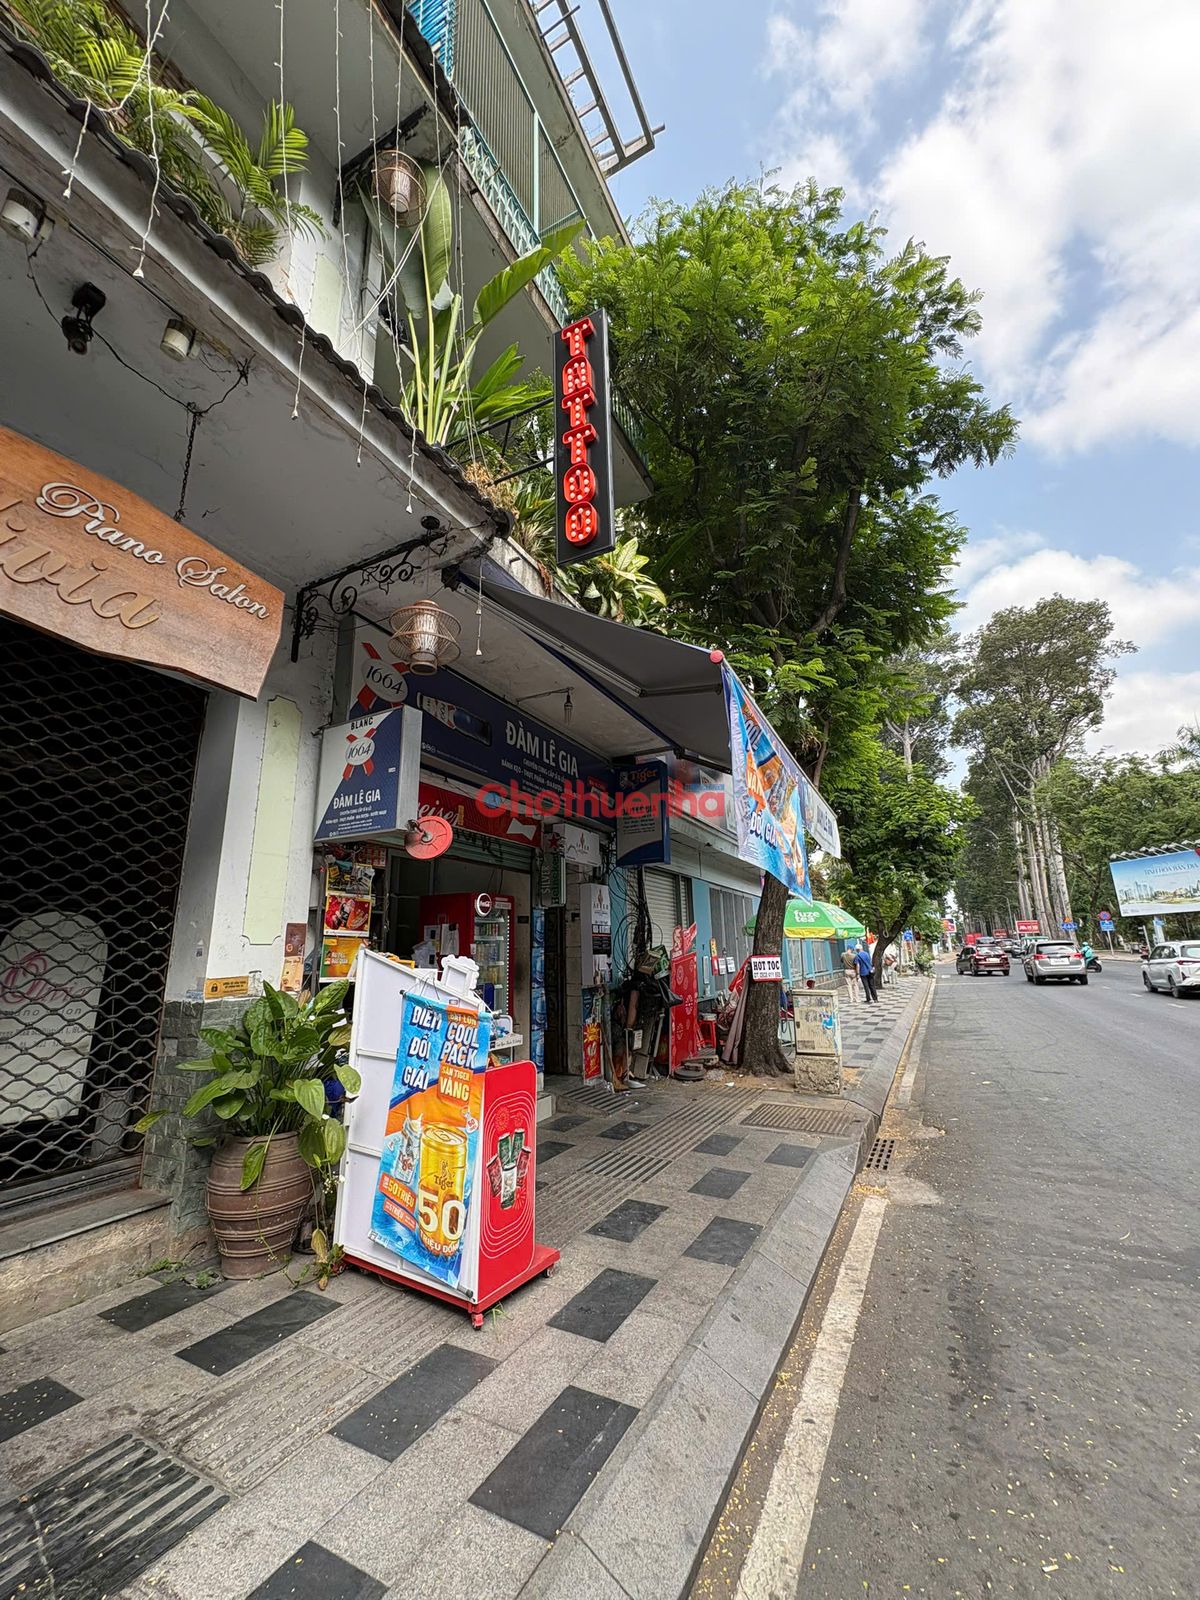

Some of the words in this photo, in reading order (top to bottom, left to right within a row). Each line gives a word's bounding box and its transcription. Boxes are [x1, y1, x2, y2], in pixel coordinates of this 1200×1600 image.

[561, 318, 598, 547] TATTOO
[36, 482, 166, 565] Piano
[176, 556, 270, 620] Salon
[366, 665, 403, 694] 1664
[350, 717, 374, 730] BLANC
[348, 743, 371, 759] 1664
[505, 720, 539, 759] ĐÀM
[543, 739, 556, 767] LÊ
[558, 750, 579, 778] GIA
[631, 767, 659, 781] Tiger
[333, 793, 353, 809] ĐÀM
[355, 790, 364, 805] LÊ
[366, 789, 381, 802] GIA
[793, 909, 820, 919] fuze
[446, 1022, 479, 1048] COOL
[440, 1041, 478, 1069] PACK
[403, 1065, 429, 1091] GIẢI
[454, 1069, 471, 1082] TIGER
[440, 1077, 470, 1102] VÀNG
[434, 1175, 454, 1190] Tiger
[418, 1190, 466, 1241] 50
[420, 1230, 441, 1251] TRIỆU
